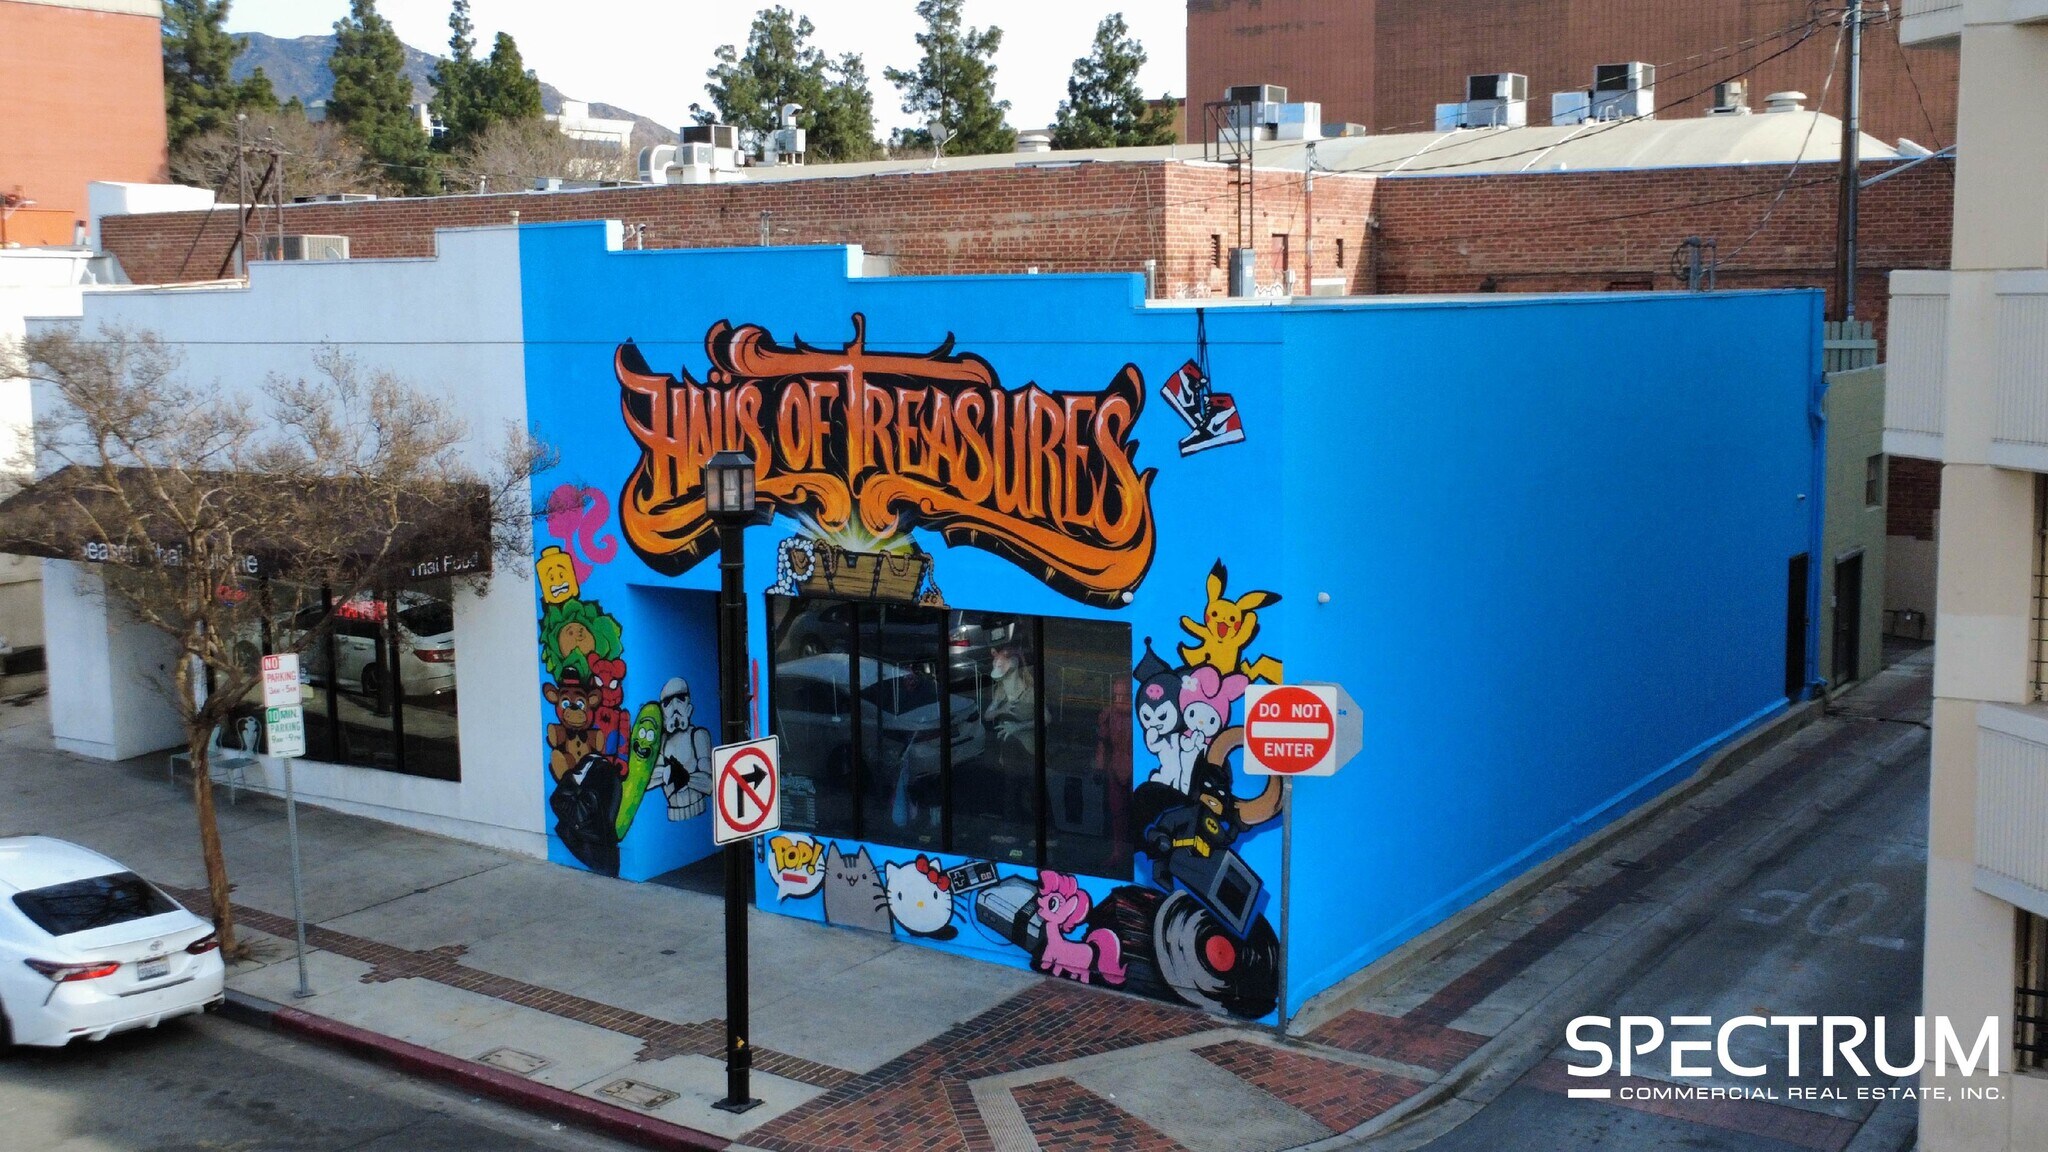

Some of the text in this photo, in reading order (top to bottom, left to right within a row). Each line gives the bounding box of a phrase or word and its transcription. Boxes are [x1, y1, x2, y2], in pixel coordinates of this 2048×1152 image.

[777, 380, 839, 474] OF
[843, 332, 1142, 535] TREASURES
[444, 551, 479, 573] Food
[264, 657, 278, 670] NO
[266, 671, 297, 683] PARKING
[268, 709, 279, 722] 10
[1260, 703, 1281, 718] DO
[1291, 703, 1322, 719] NOT
[270, 721, 301, 733] PARKING
[1264, 742, 1315, 758] ENTER
[768, 836, 826, 875] POP!
